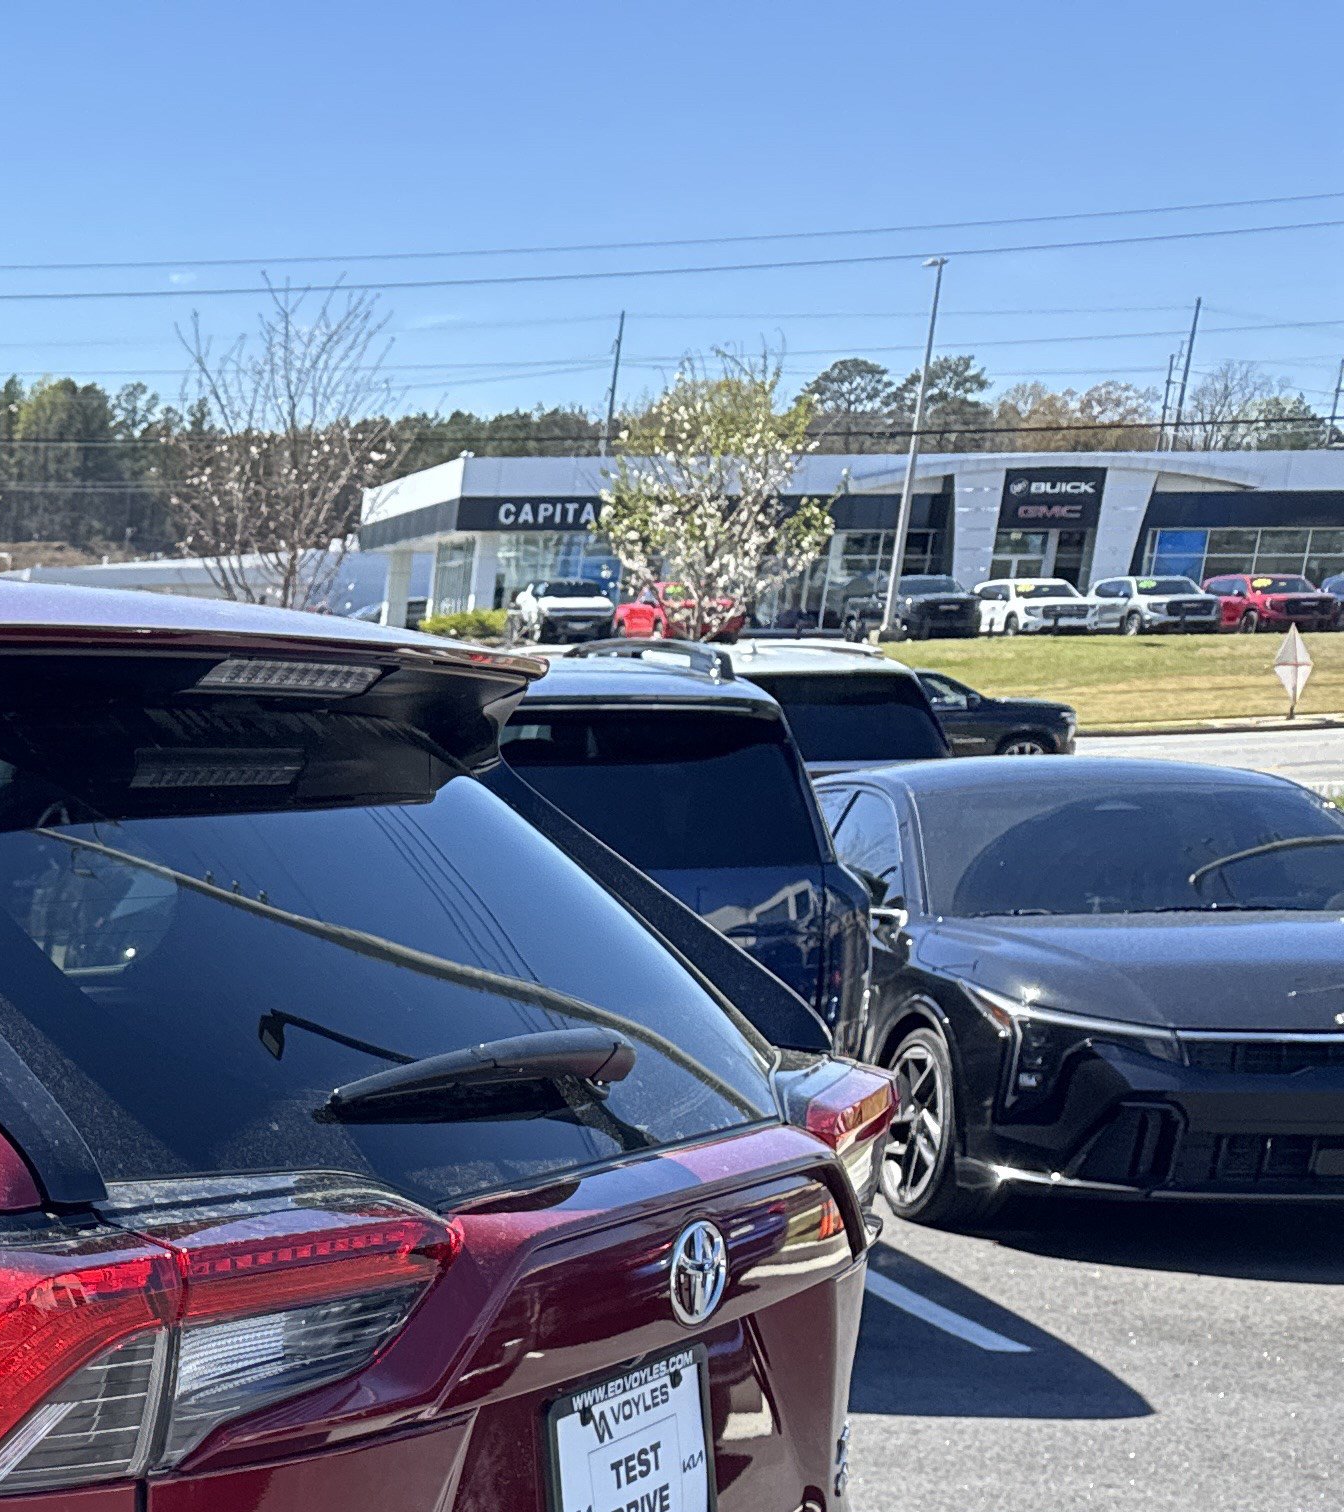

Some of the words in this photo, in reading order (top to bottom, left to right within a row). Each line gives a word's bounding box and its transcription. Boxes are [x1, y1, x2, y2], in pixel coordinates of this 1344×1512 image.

[1030, 481, 1096, 494] BUICK
[498, 502, 598, 525] CAPITA
[1017, 505, 1083, 518] GMC
[572, 1349, 694, 1412] WWW.EDVOYLES.COM
[610, 1382, 670, 1425] VOYLES
[610, 1441, 662, 1490] TEST
